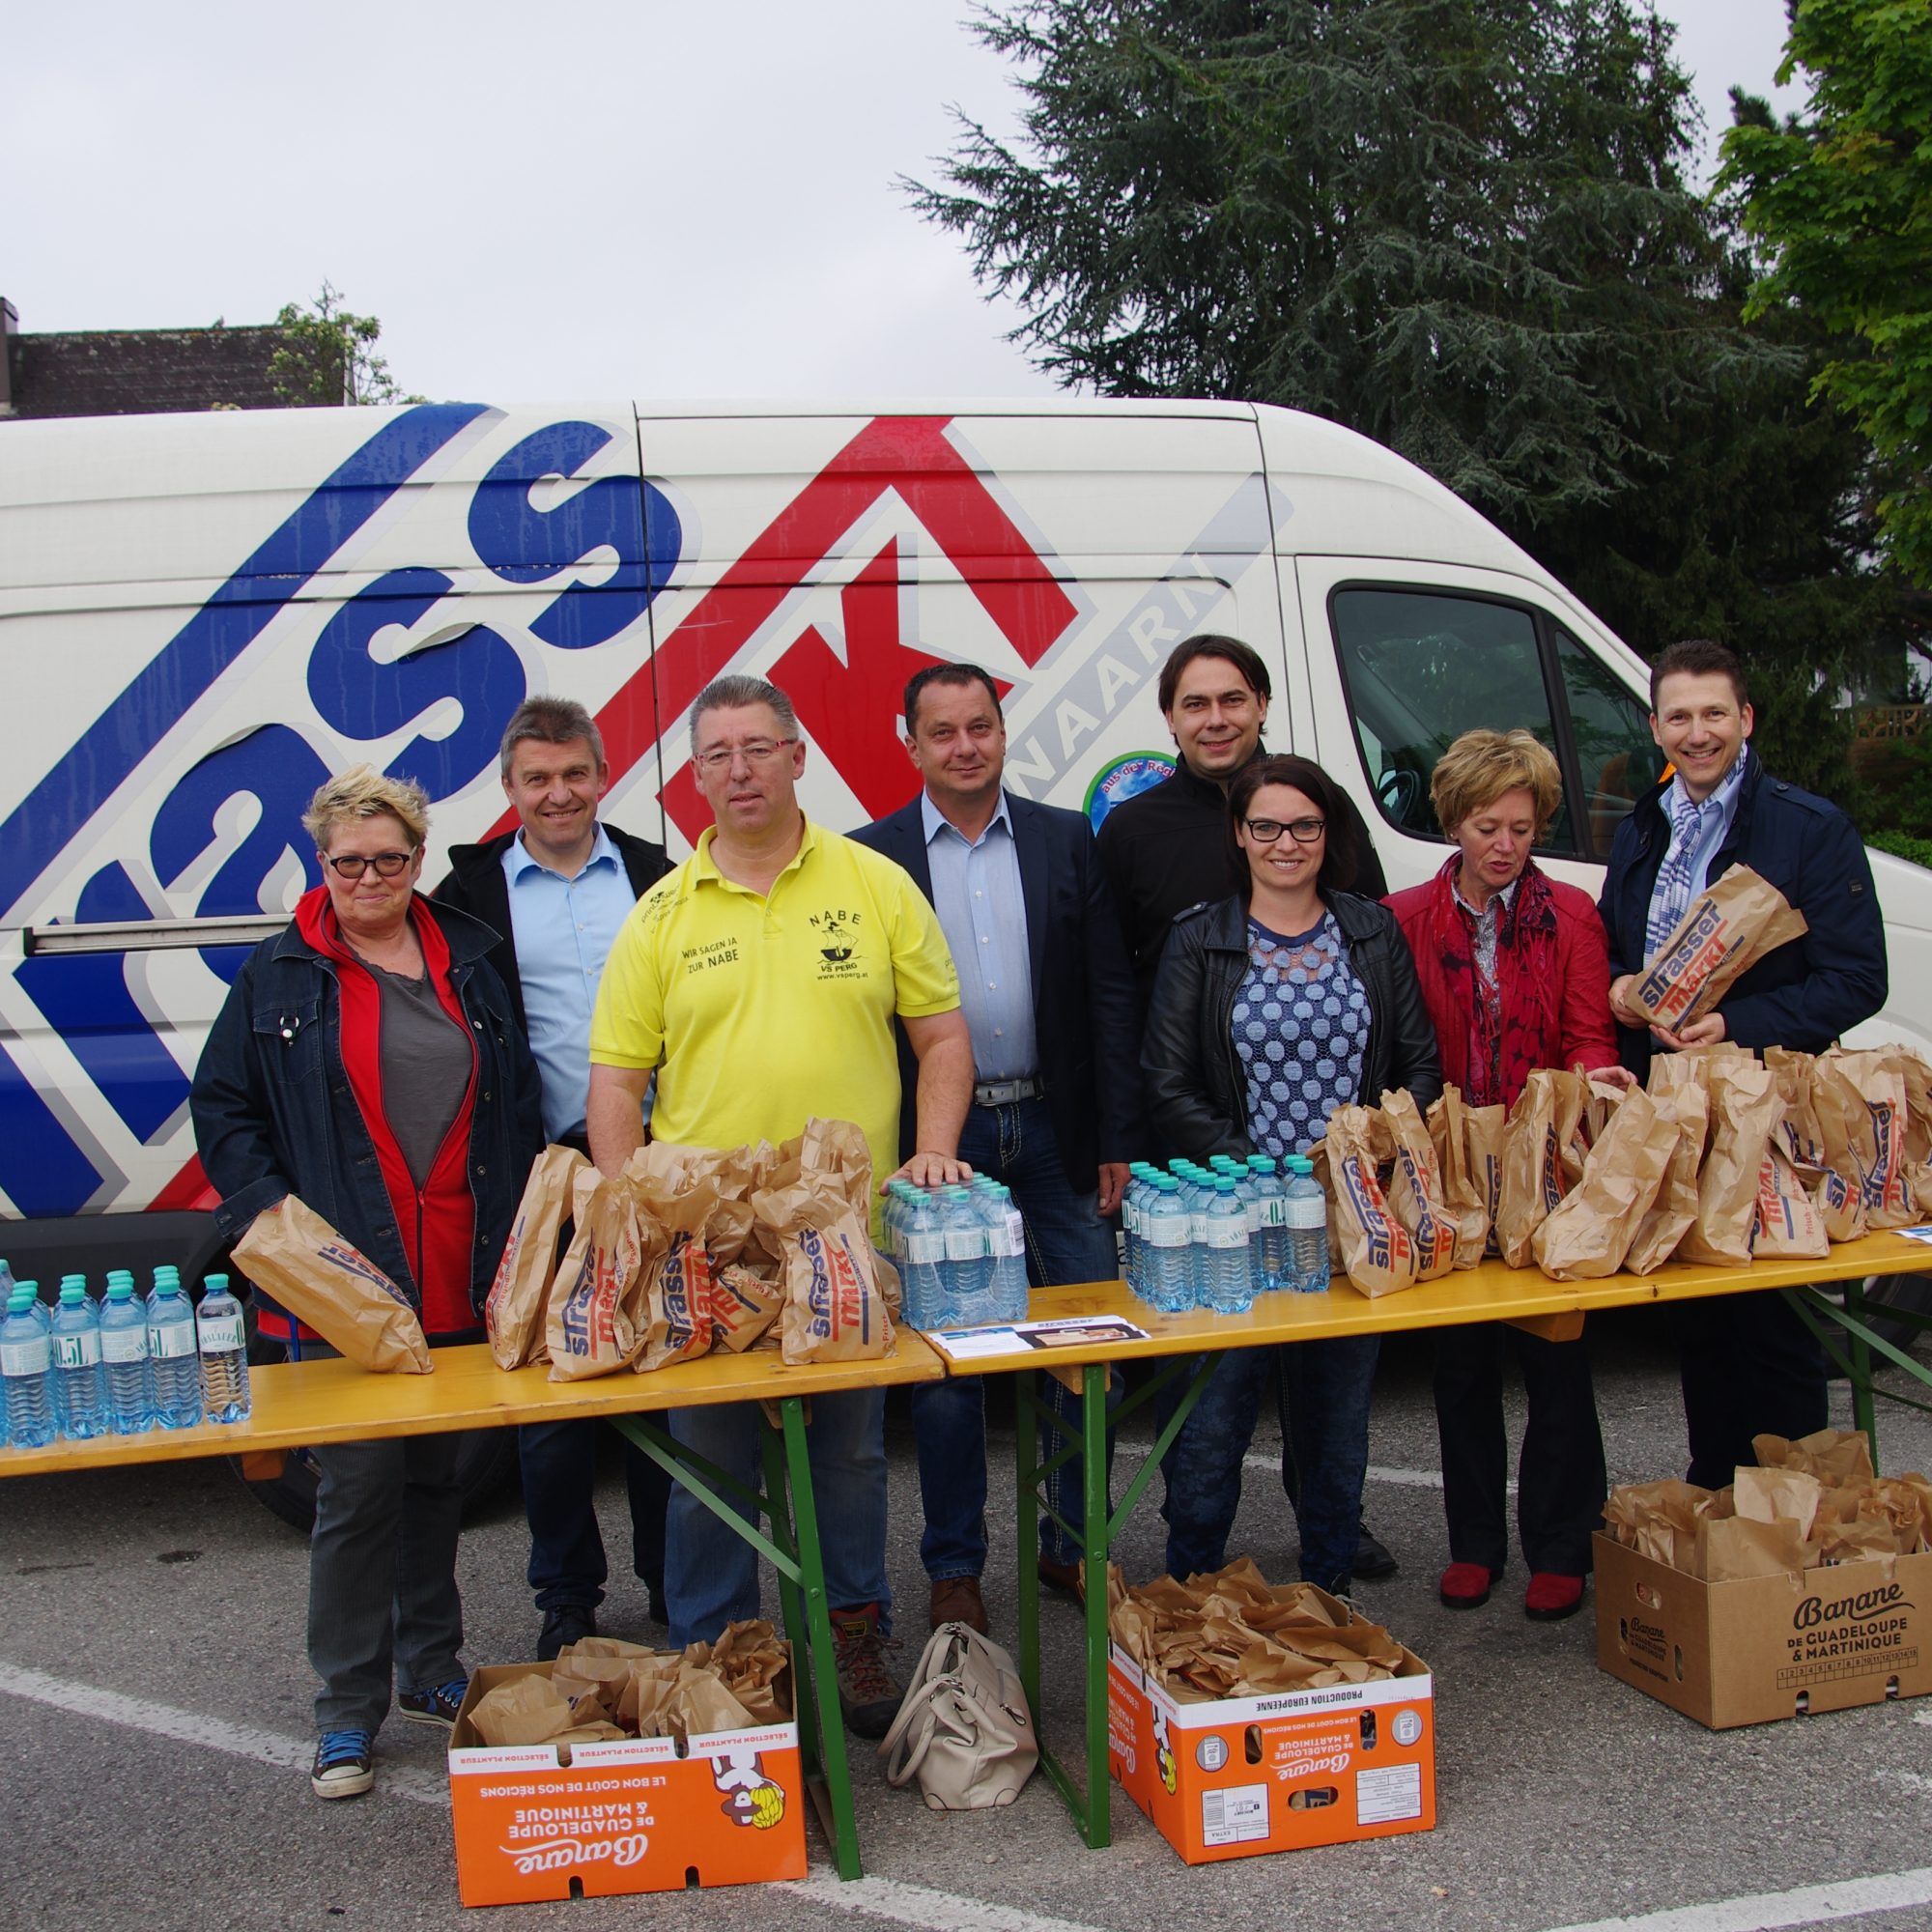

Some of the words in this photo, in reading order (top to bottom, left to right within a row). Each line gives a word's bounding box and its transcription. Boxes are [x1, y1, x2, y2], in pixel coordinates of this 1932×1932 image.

[1102, 772, 1122, 793] aus
[1122, 761, 1143, 776] der
[1148, 760, 1176, 778] Regi
[810, 910, 862, 927] NABE
[682, 949, 697, 959] WIR
[699, 940, 726, 956] SAGEN
[726, 936, 738, 948] JA
[688, 961, 704, 974] ZUR
[707, 949, 740, 968] NABE
[835, 963, 858, 972] PERG
[1793, 1582, 1916, 1631] Banane
[1787, 1638, 1803, 1648] DE
[1805, 1617, 1908, 1646] GUADELOUPE
[1792, 1650, 1803, 1662] &
[1806, 1633, 1902, 1661] MARTINIQUE
[1256, 1696, 1310, 1712] EUROPÉENNE
[1312, 1690, 1362, 1705] PRODUCTION
[698, 1739, 740, 1748] PLANTEUR
[742, 1732, 788, 1745] SÉLECTION
[1278, 1736, 1339, 1750] MARTINIQUE
[580, 1749, 622, 1758] PLANTEUR
[624, 1745, 669, 1755] SÉLECTION
[1274, 1744, 1341, 1759] GUADELOUPE
[504, 1753, 550, 1762] SÉLECTION
[1270, 1752, 1350, 1780] Banane
[583, 1780, 619, 1791] GOÛT
[622, 1778, 650, 1787] BON
[652, 1776, 667, 1785] LE
[480, 1785, 534, 1799] RÉGIONS
[538, 1784, 563, 1794] NOS
[516, 1803, 632, 1822] MARTINIQUE
[637, 1802, 648, 1812] &
[509, 1817, 632, 1838] GUADELOUPE
[644, 1816, 654, 1825] DE
[499, 1834, 648, 1875] Banane
